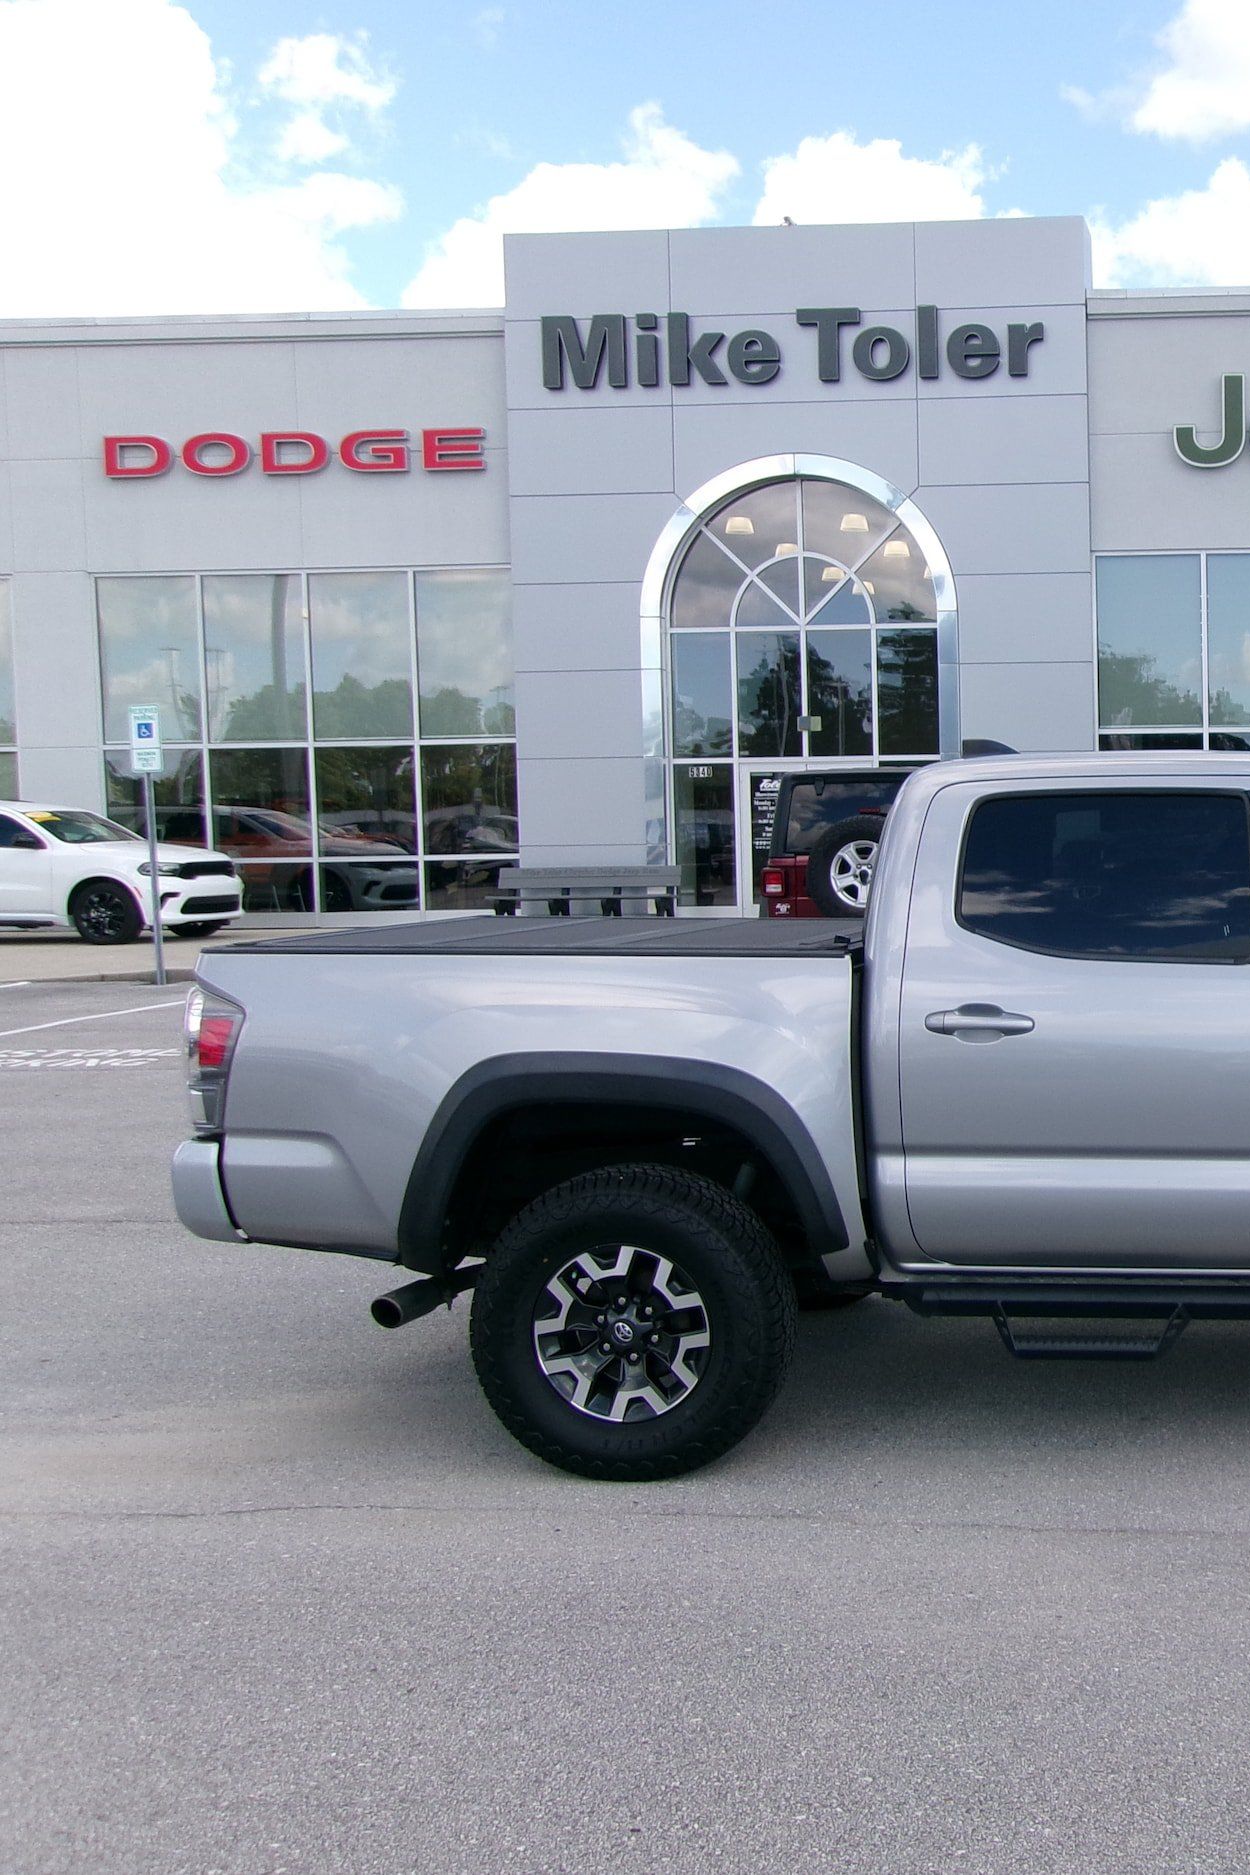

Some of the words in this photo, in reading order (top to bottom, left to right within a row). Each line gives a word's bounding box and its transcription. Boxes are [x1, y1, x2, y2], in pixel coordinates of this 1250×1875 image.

[540, 312, 781, 388] Mike
[796, 305, 1044, 383] Toler
[104, 427, 487, 478] DODGE
